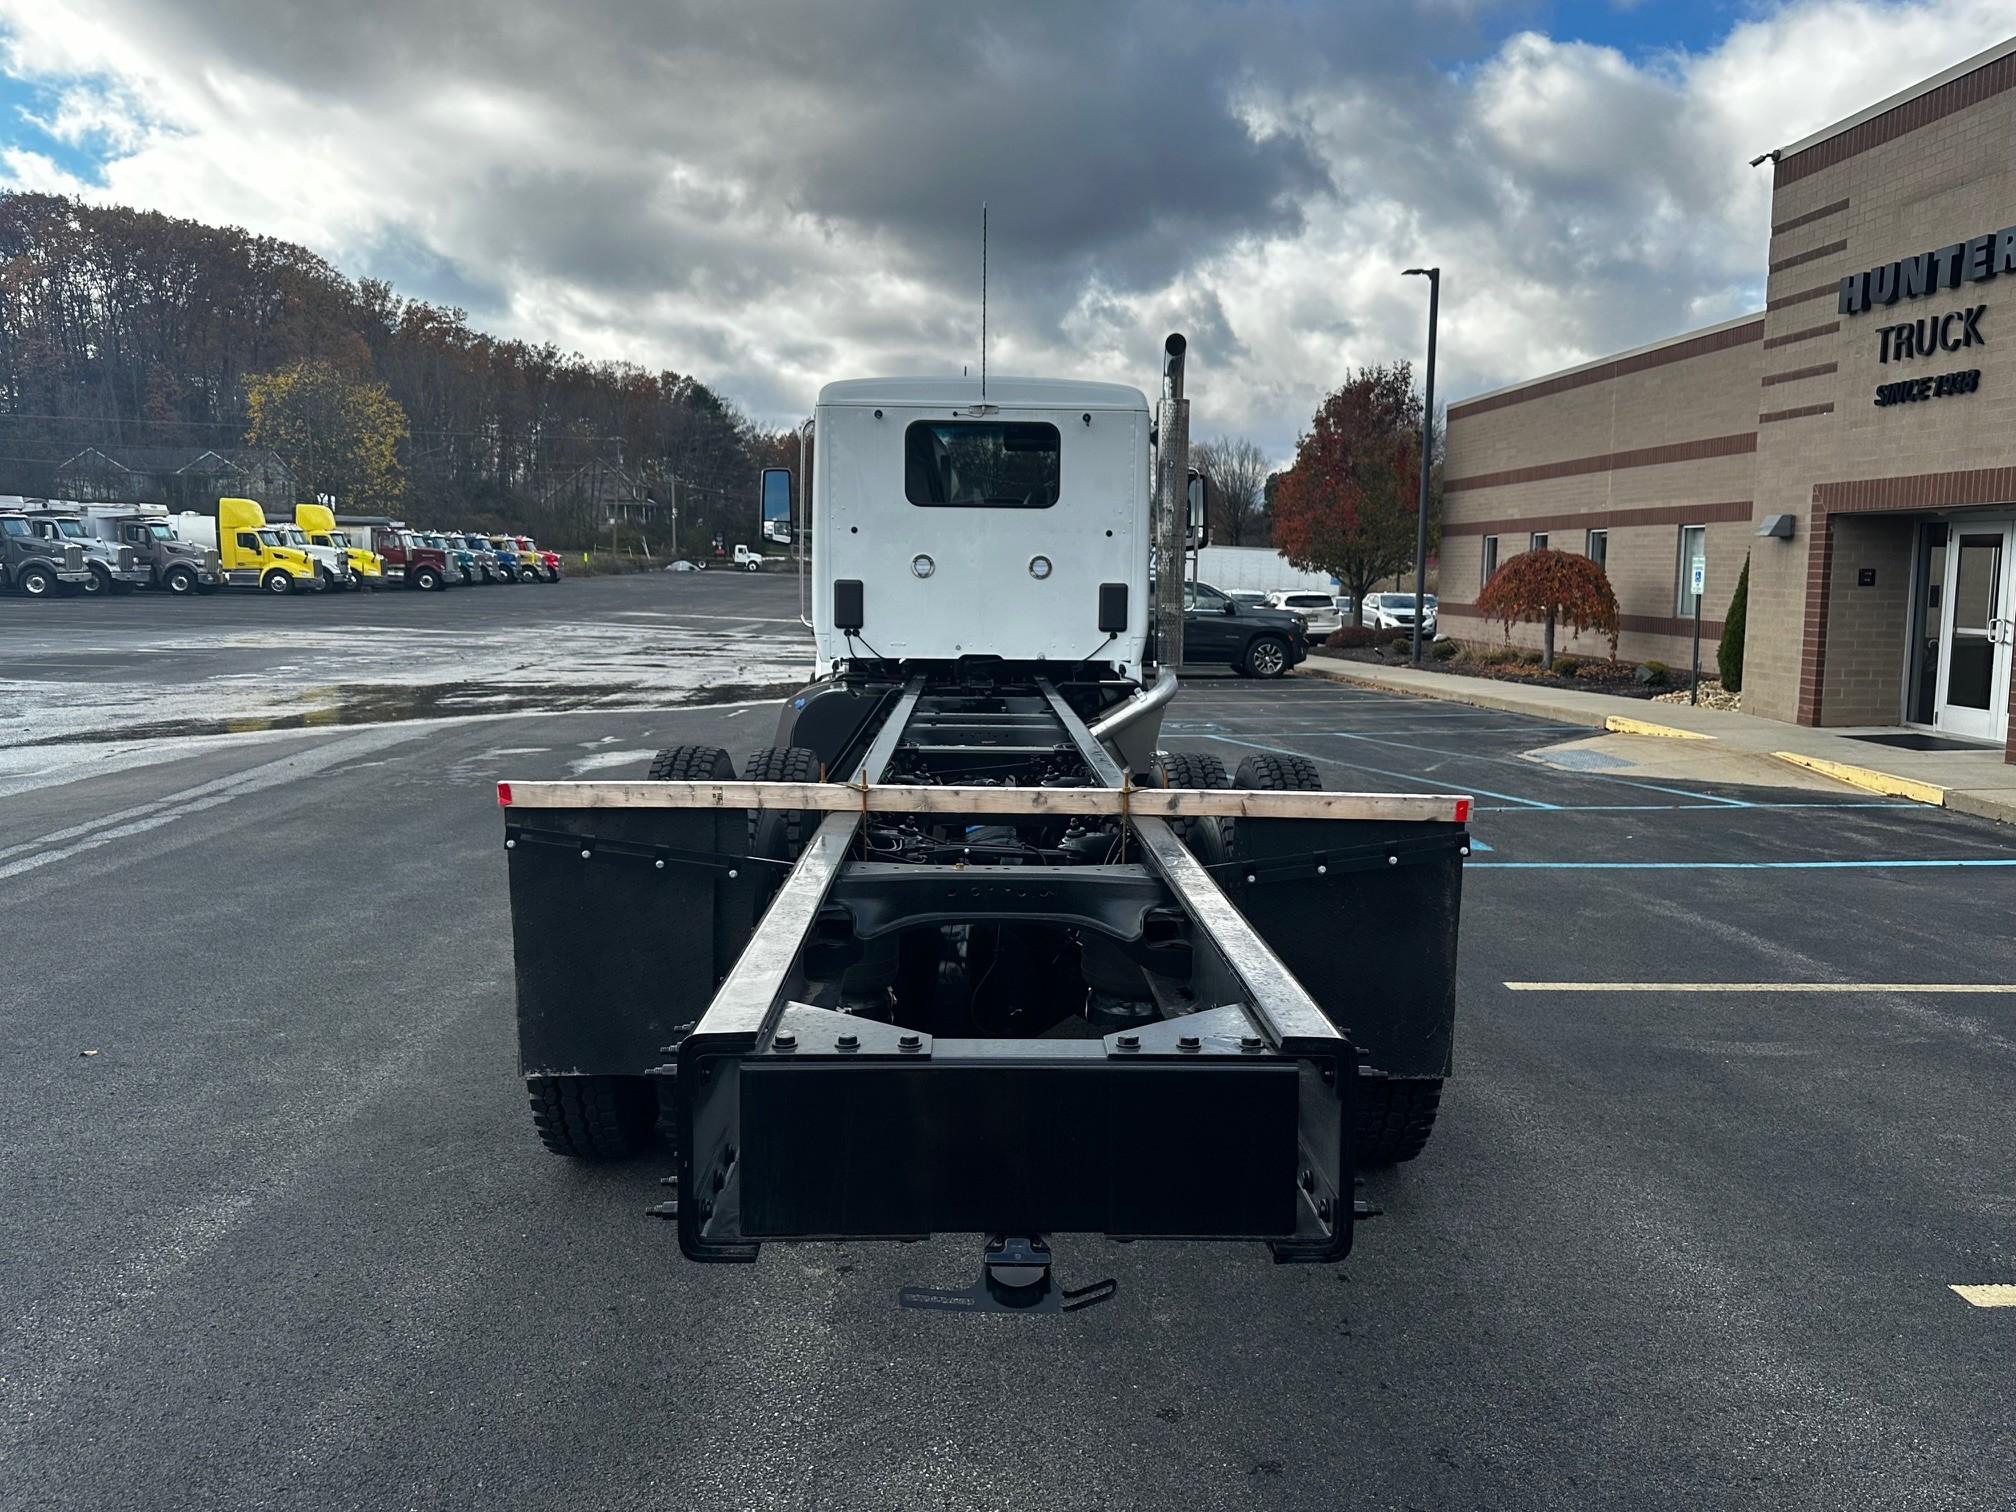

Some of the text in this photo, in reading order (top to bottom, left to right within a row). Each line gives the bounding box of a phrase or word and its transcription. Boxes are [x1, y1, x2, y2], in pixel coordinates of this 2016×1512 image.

[1838, 225, 2016, 316] HUNTER
[1875, 304, 1988, 364] TRUCK
[1873, 376, 1935, 407] SINCE
